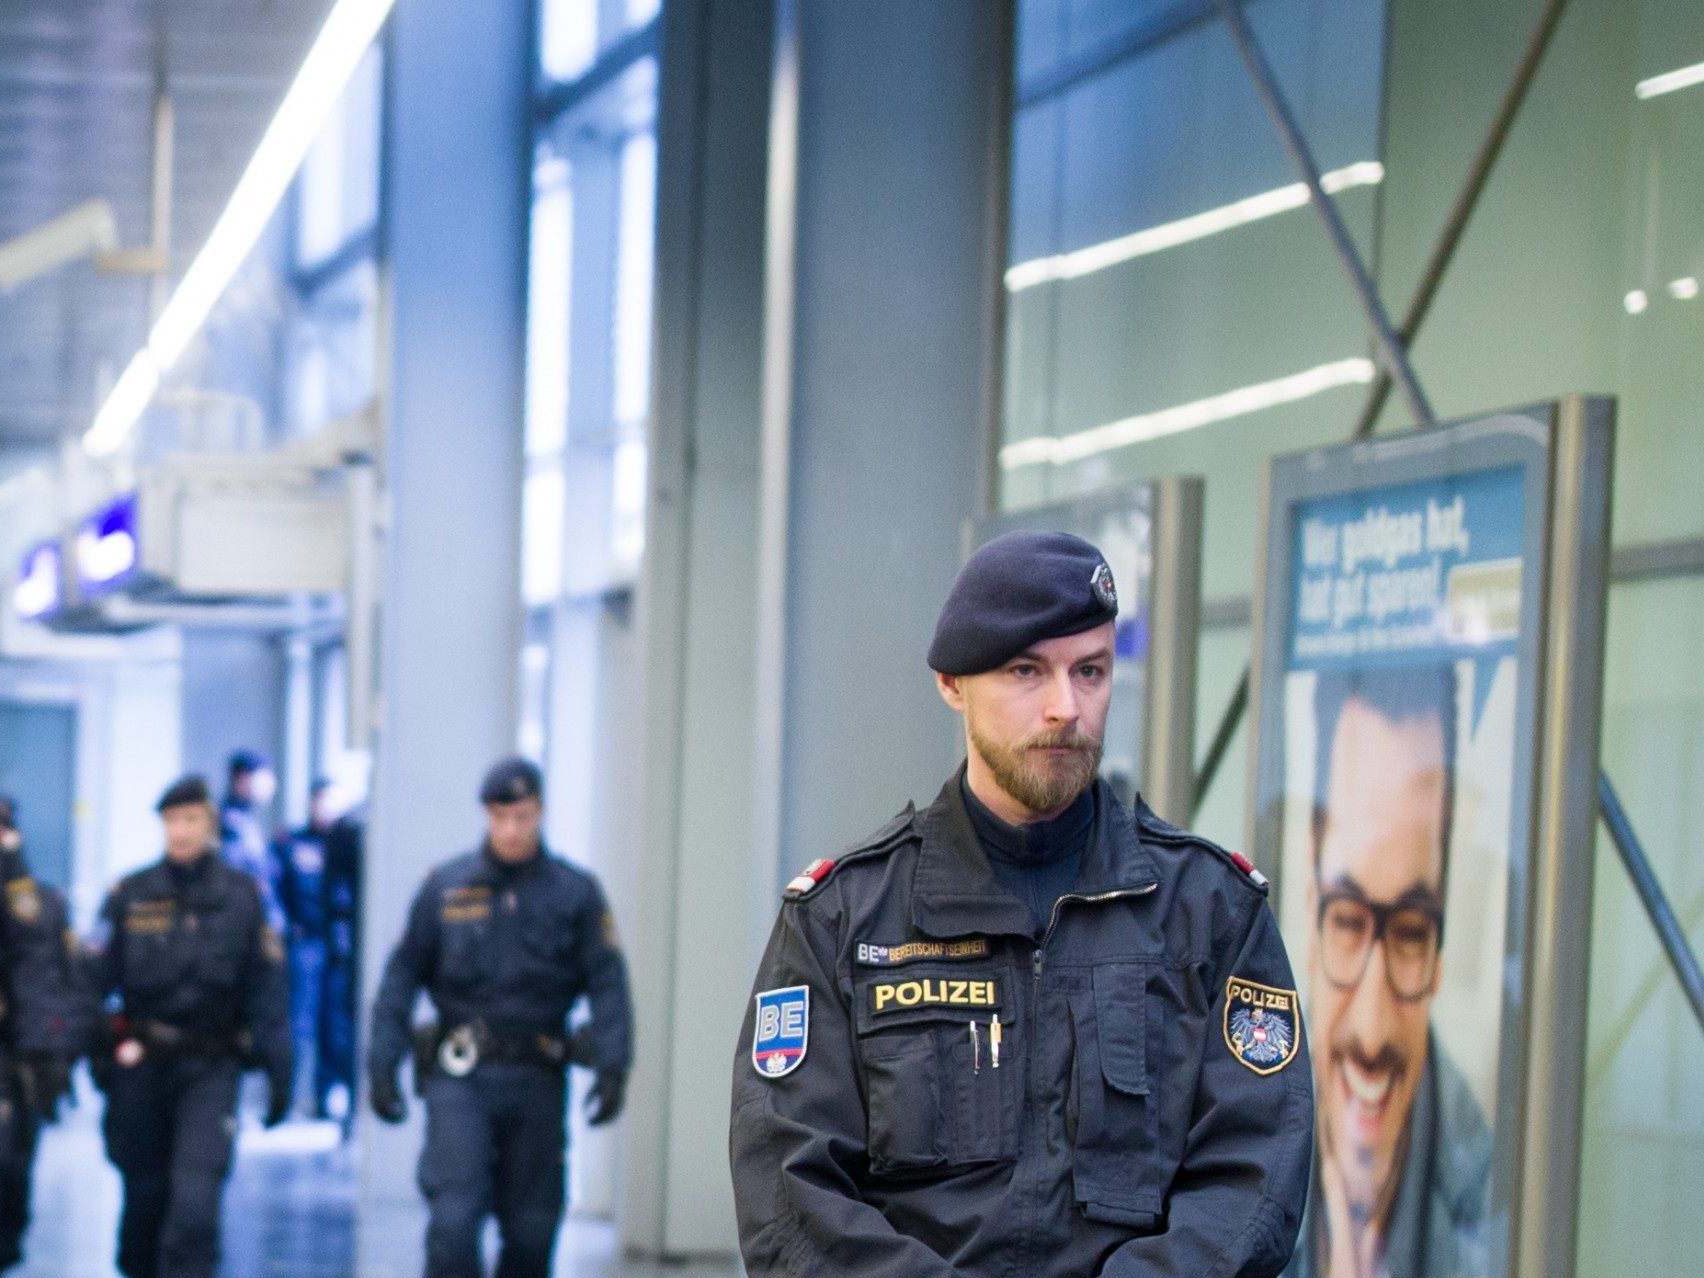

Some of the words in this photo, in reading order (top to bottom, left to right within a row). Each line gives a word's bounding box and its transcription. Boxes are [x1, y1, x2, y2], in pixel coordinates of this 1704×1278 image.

[858, 942, 880, 963] BE
[875, 979, 995, 1011] POLIZEI
[758, 1001, 804, 1042] BE
